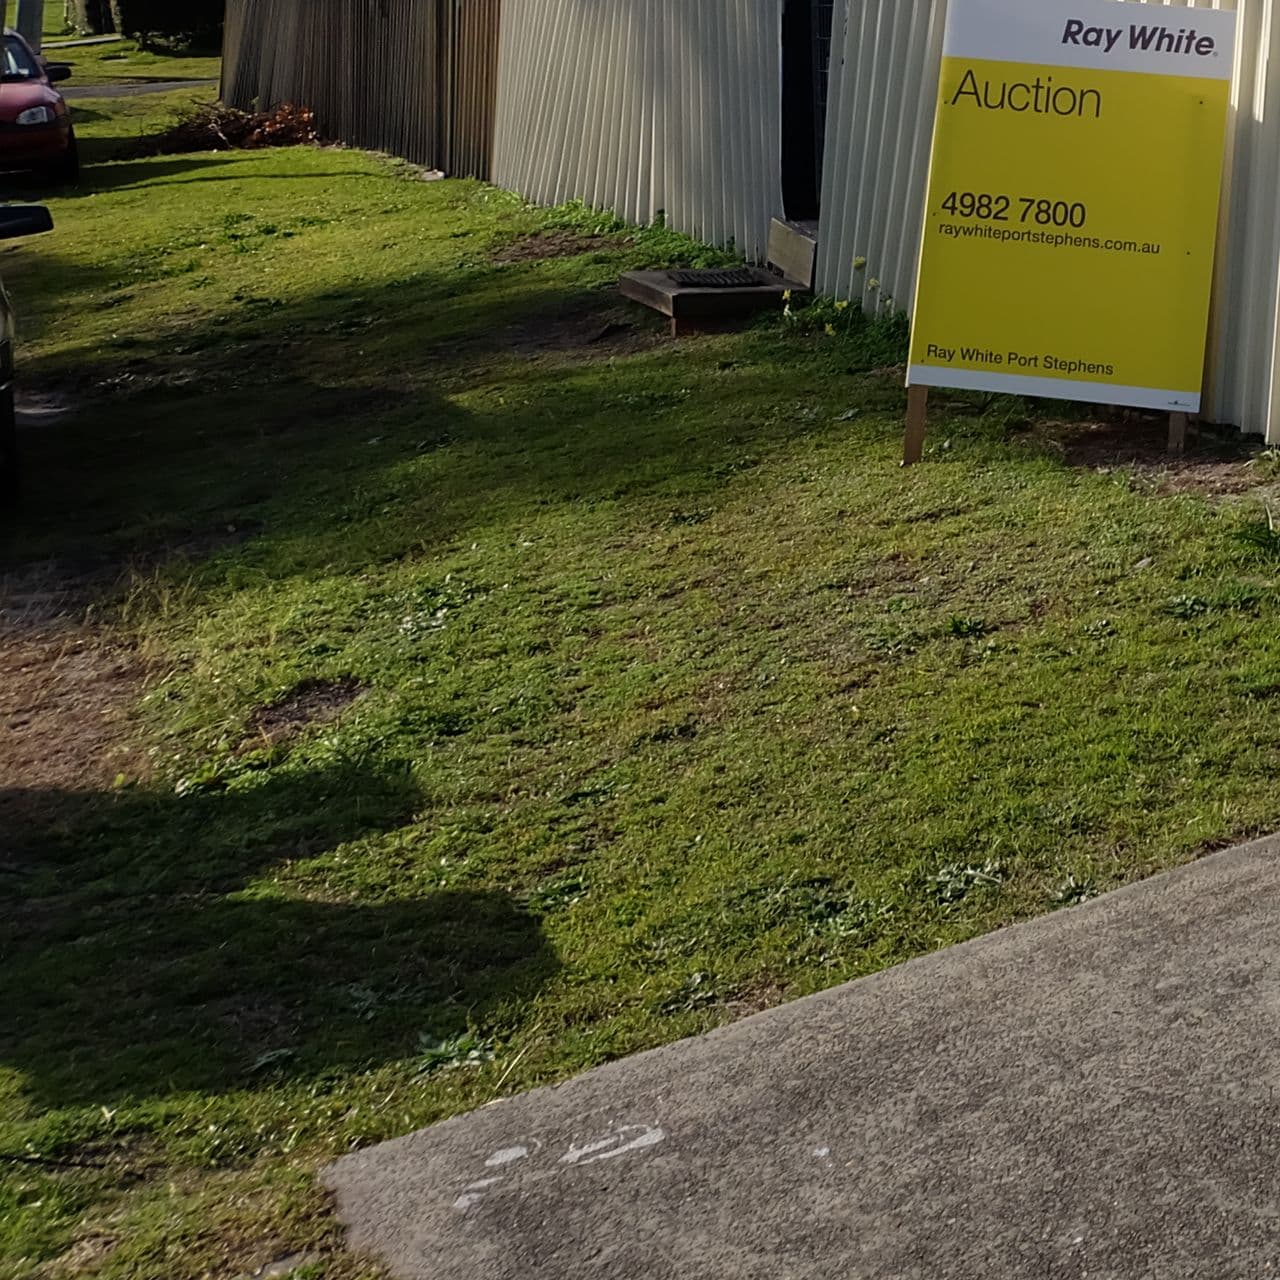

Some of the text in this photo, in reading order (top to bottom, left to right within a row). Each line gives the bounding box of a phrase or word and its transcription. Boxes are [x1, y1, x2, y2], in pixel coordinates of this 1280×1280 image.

[1061, 19, 1216, 57] Ray White
[950, 69, 1102, 118] Auction
[940, 191, 1087, 228] 4982 7800
[938, 222, 1161, 254] raywhiteportstephens.com.au
[926, 344, 1114, 376] Ray White Port Stephens
